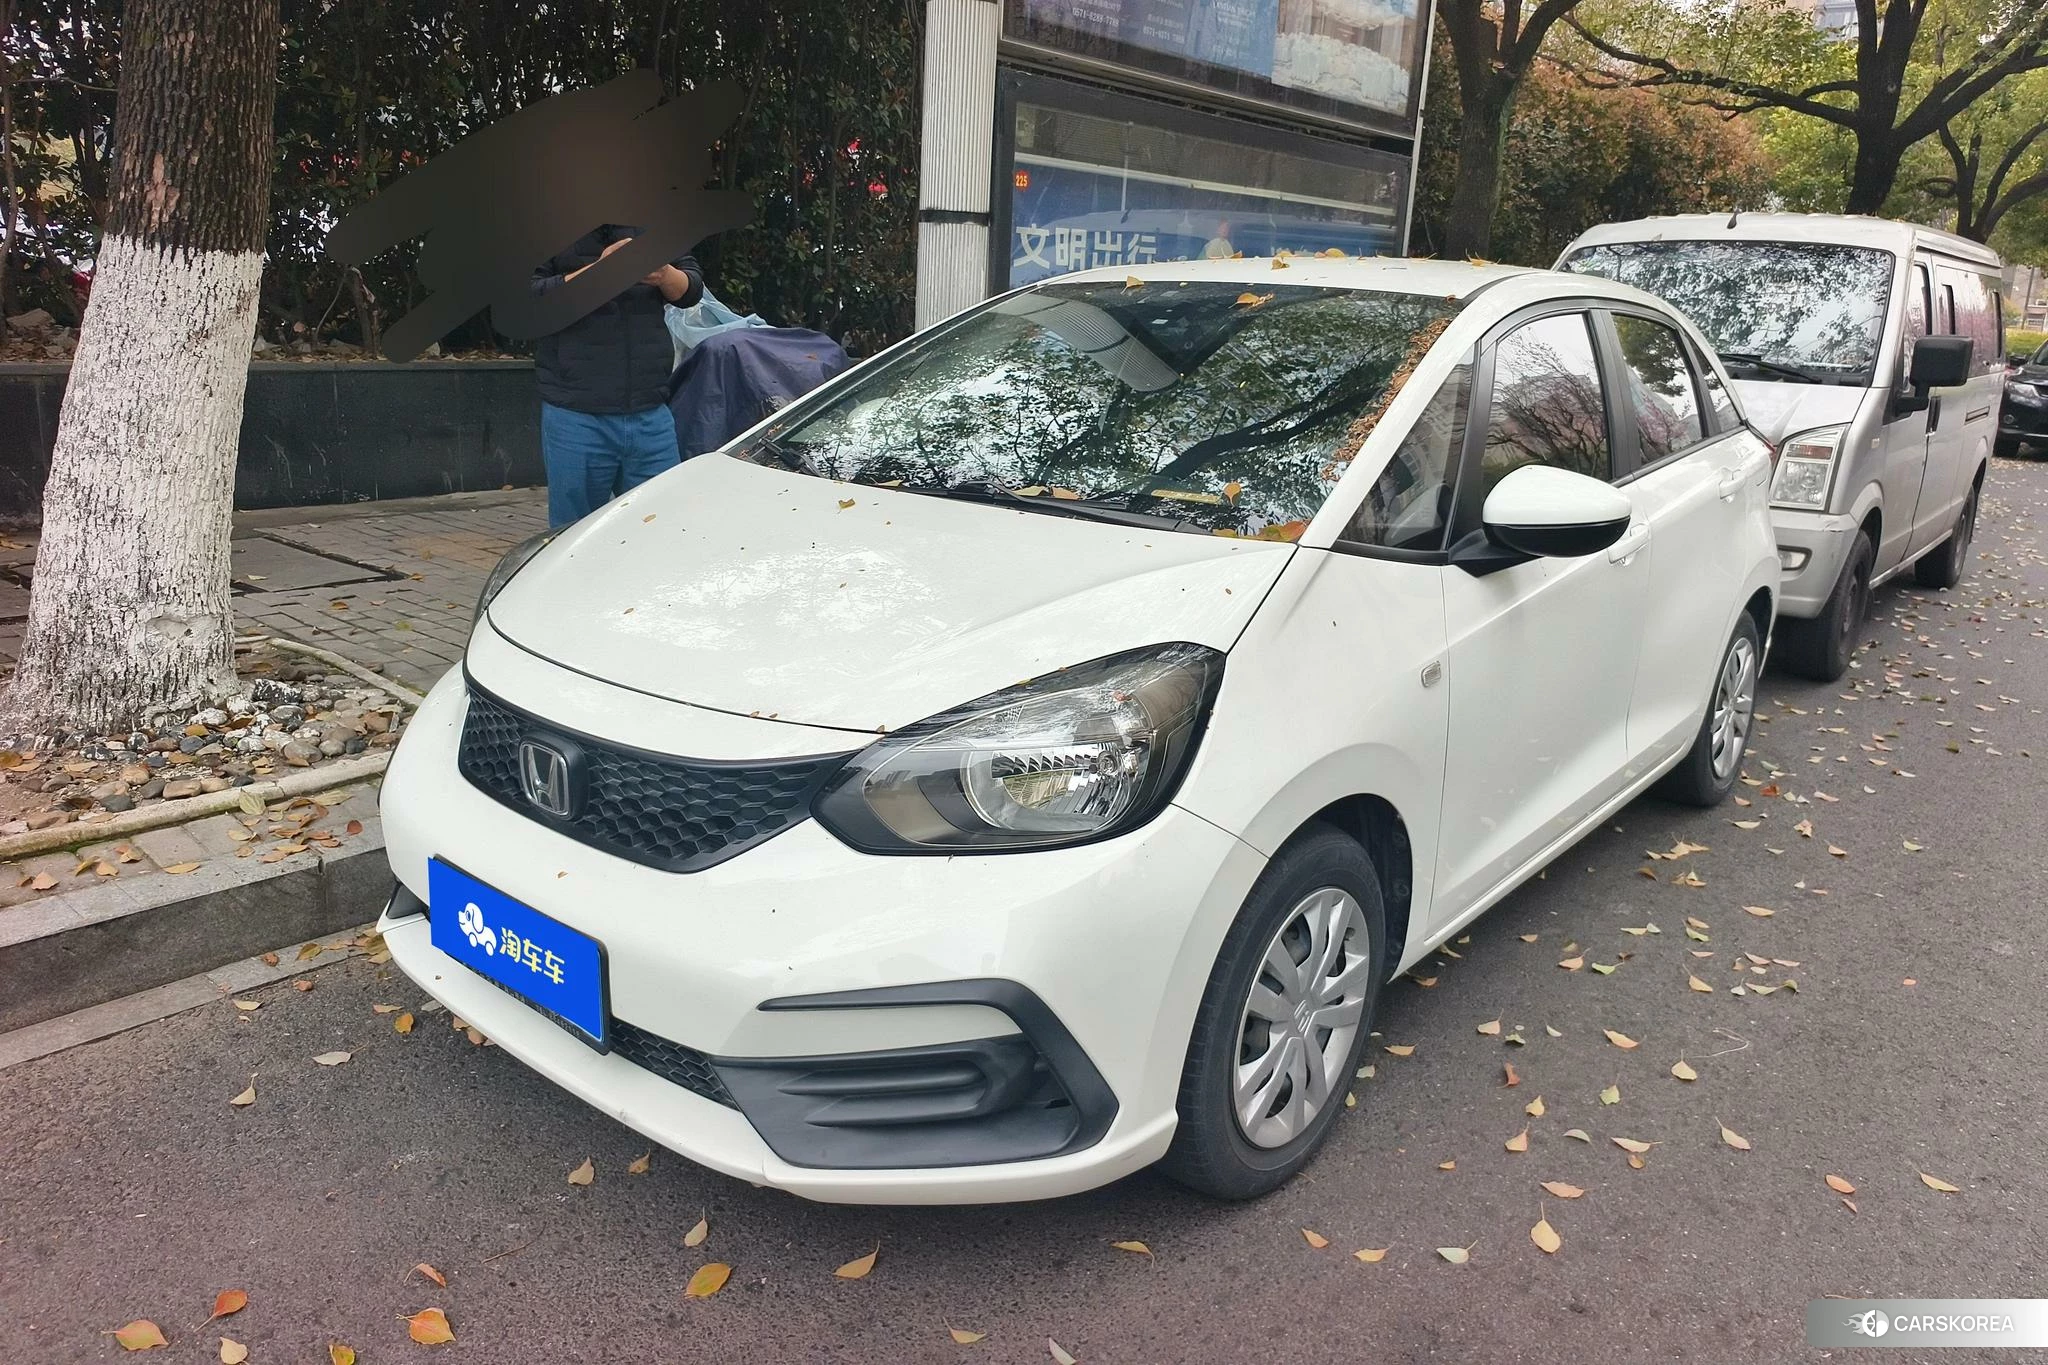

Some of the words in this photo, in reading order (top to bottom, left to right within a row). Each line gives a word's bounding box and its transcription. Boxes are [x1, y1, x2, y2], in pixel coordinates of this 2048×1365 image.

[1015, 175, 1028, 187] 225
[1013, 223, 1157, 271] 文明出行
